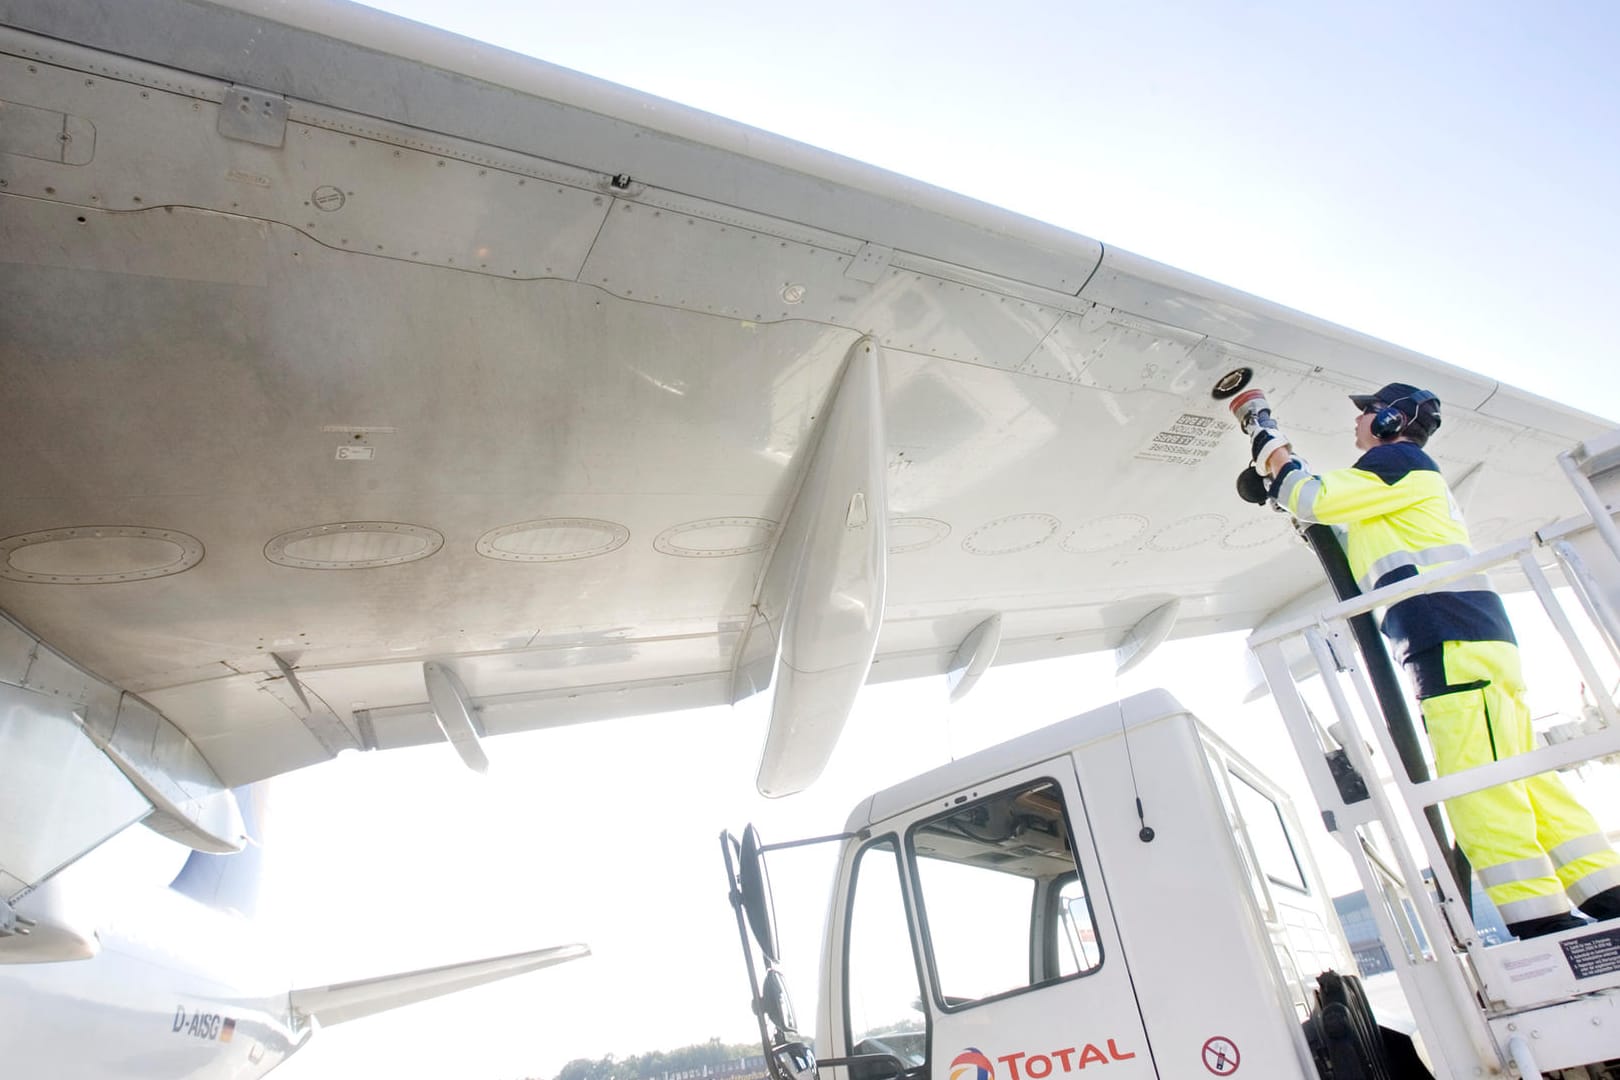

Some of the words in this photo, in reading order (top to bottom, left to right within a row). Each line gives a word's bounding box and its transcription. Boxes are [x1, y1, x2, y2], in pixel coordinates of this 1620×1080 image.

[1149, 443, 1193, 454] PRESSURE
[172, 1004, 220, 1040] D-AISG
[997, 1038, 1136, 1080] TOTAL
